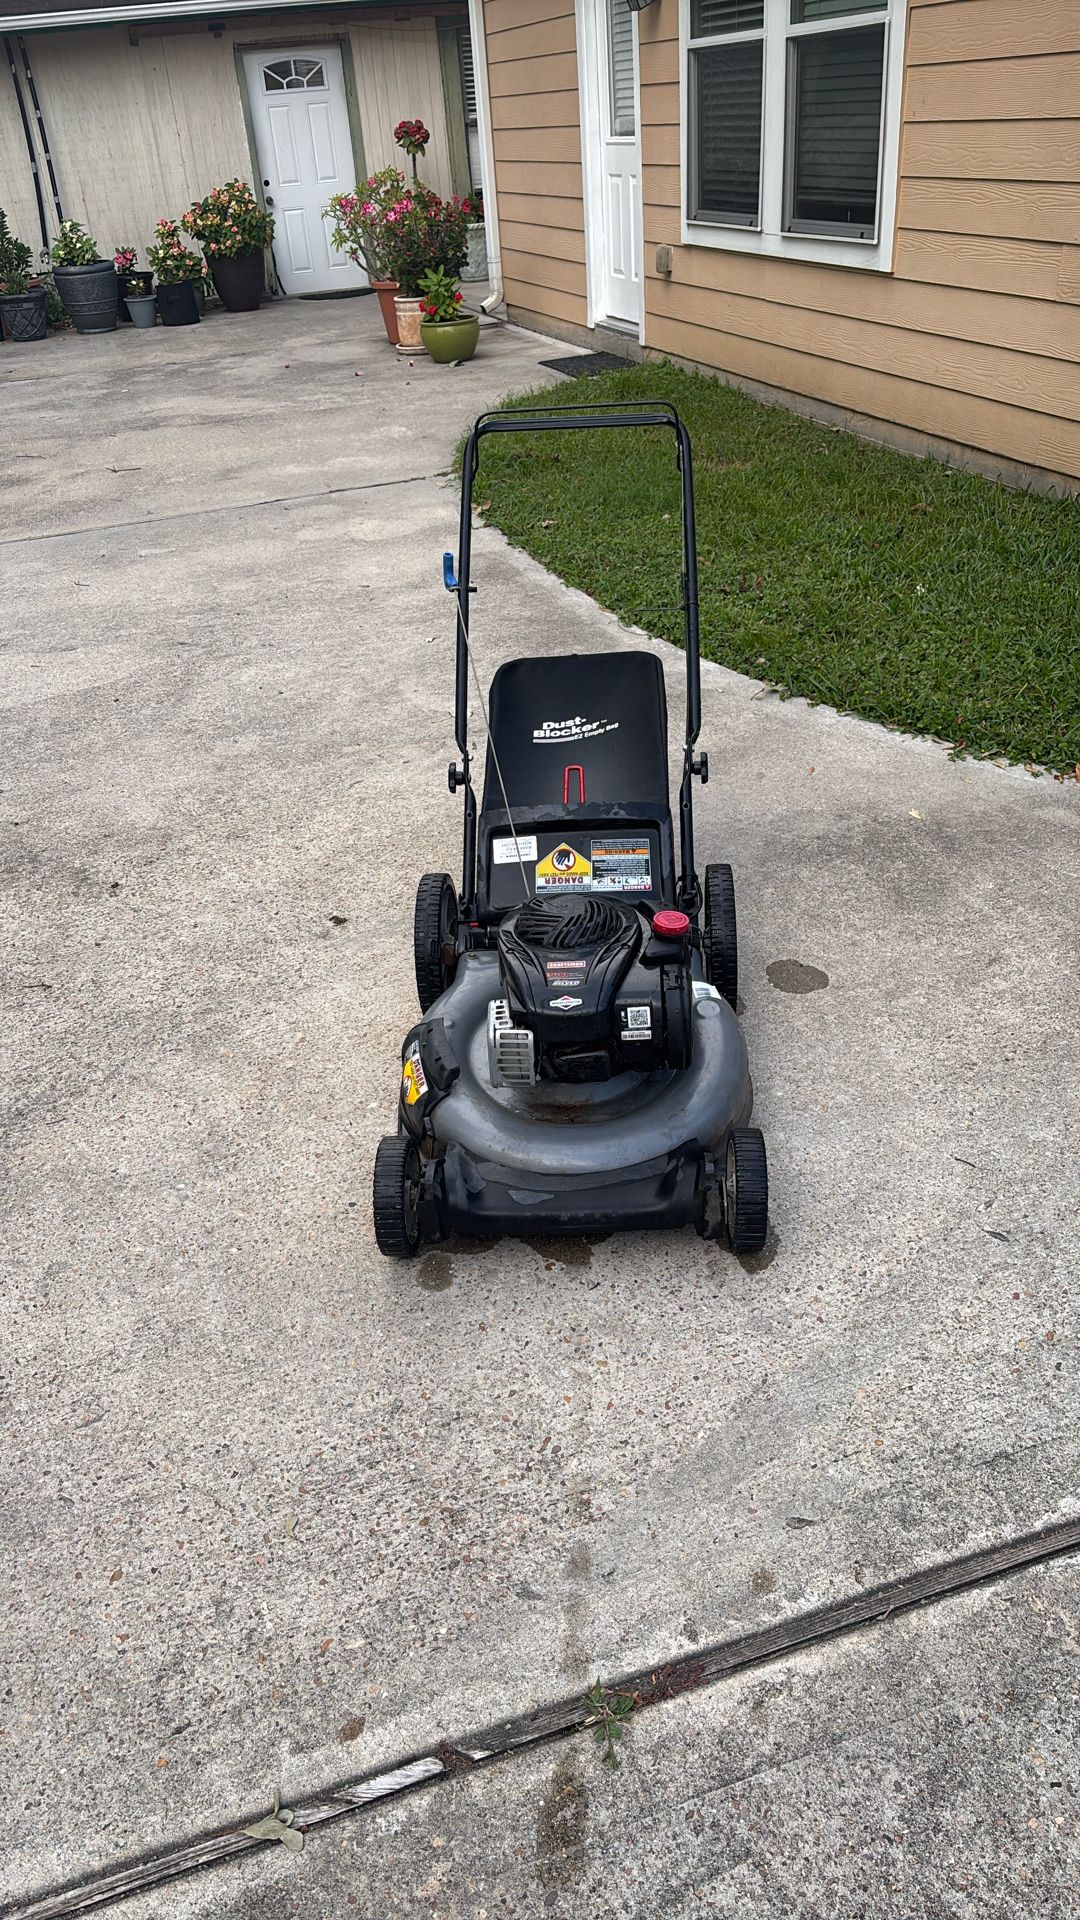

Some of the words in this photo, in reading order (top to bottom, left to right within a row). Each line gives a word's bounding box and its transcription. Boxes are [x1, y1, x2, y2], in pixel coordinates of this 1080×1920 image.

[533, 721, 600, 738] Blocker
[542, 716, 587, 730] Dust-
[584, 727, 606, 738] Empty
[544, 876, 583, 884] DANGER
[413, 1058, 425, 1088] DANGER
